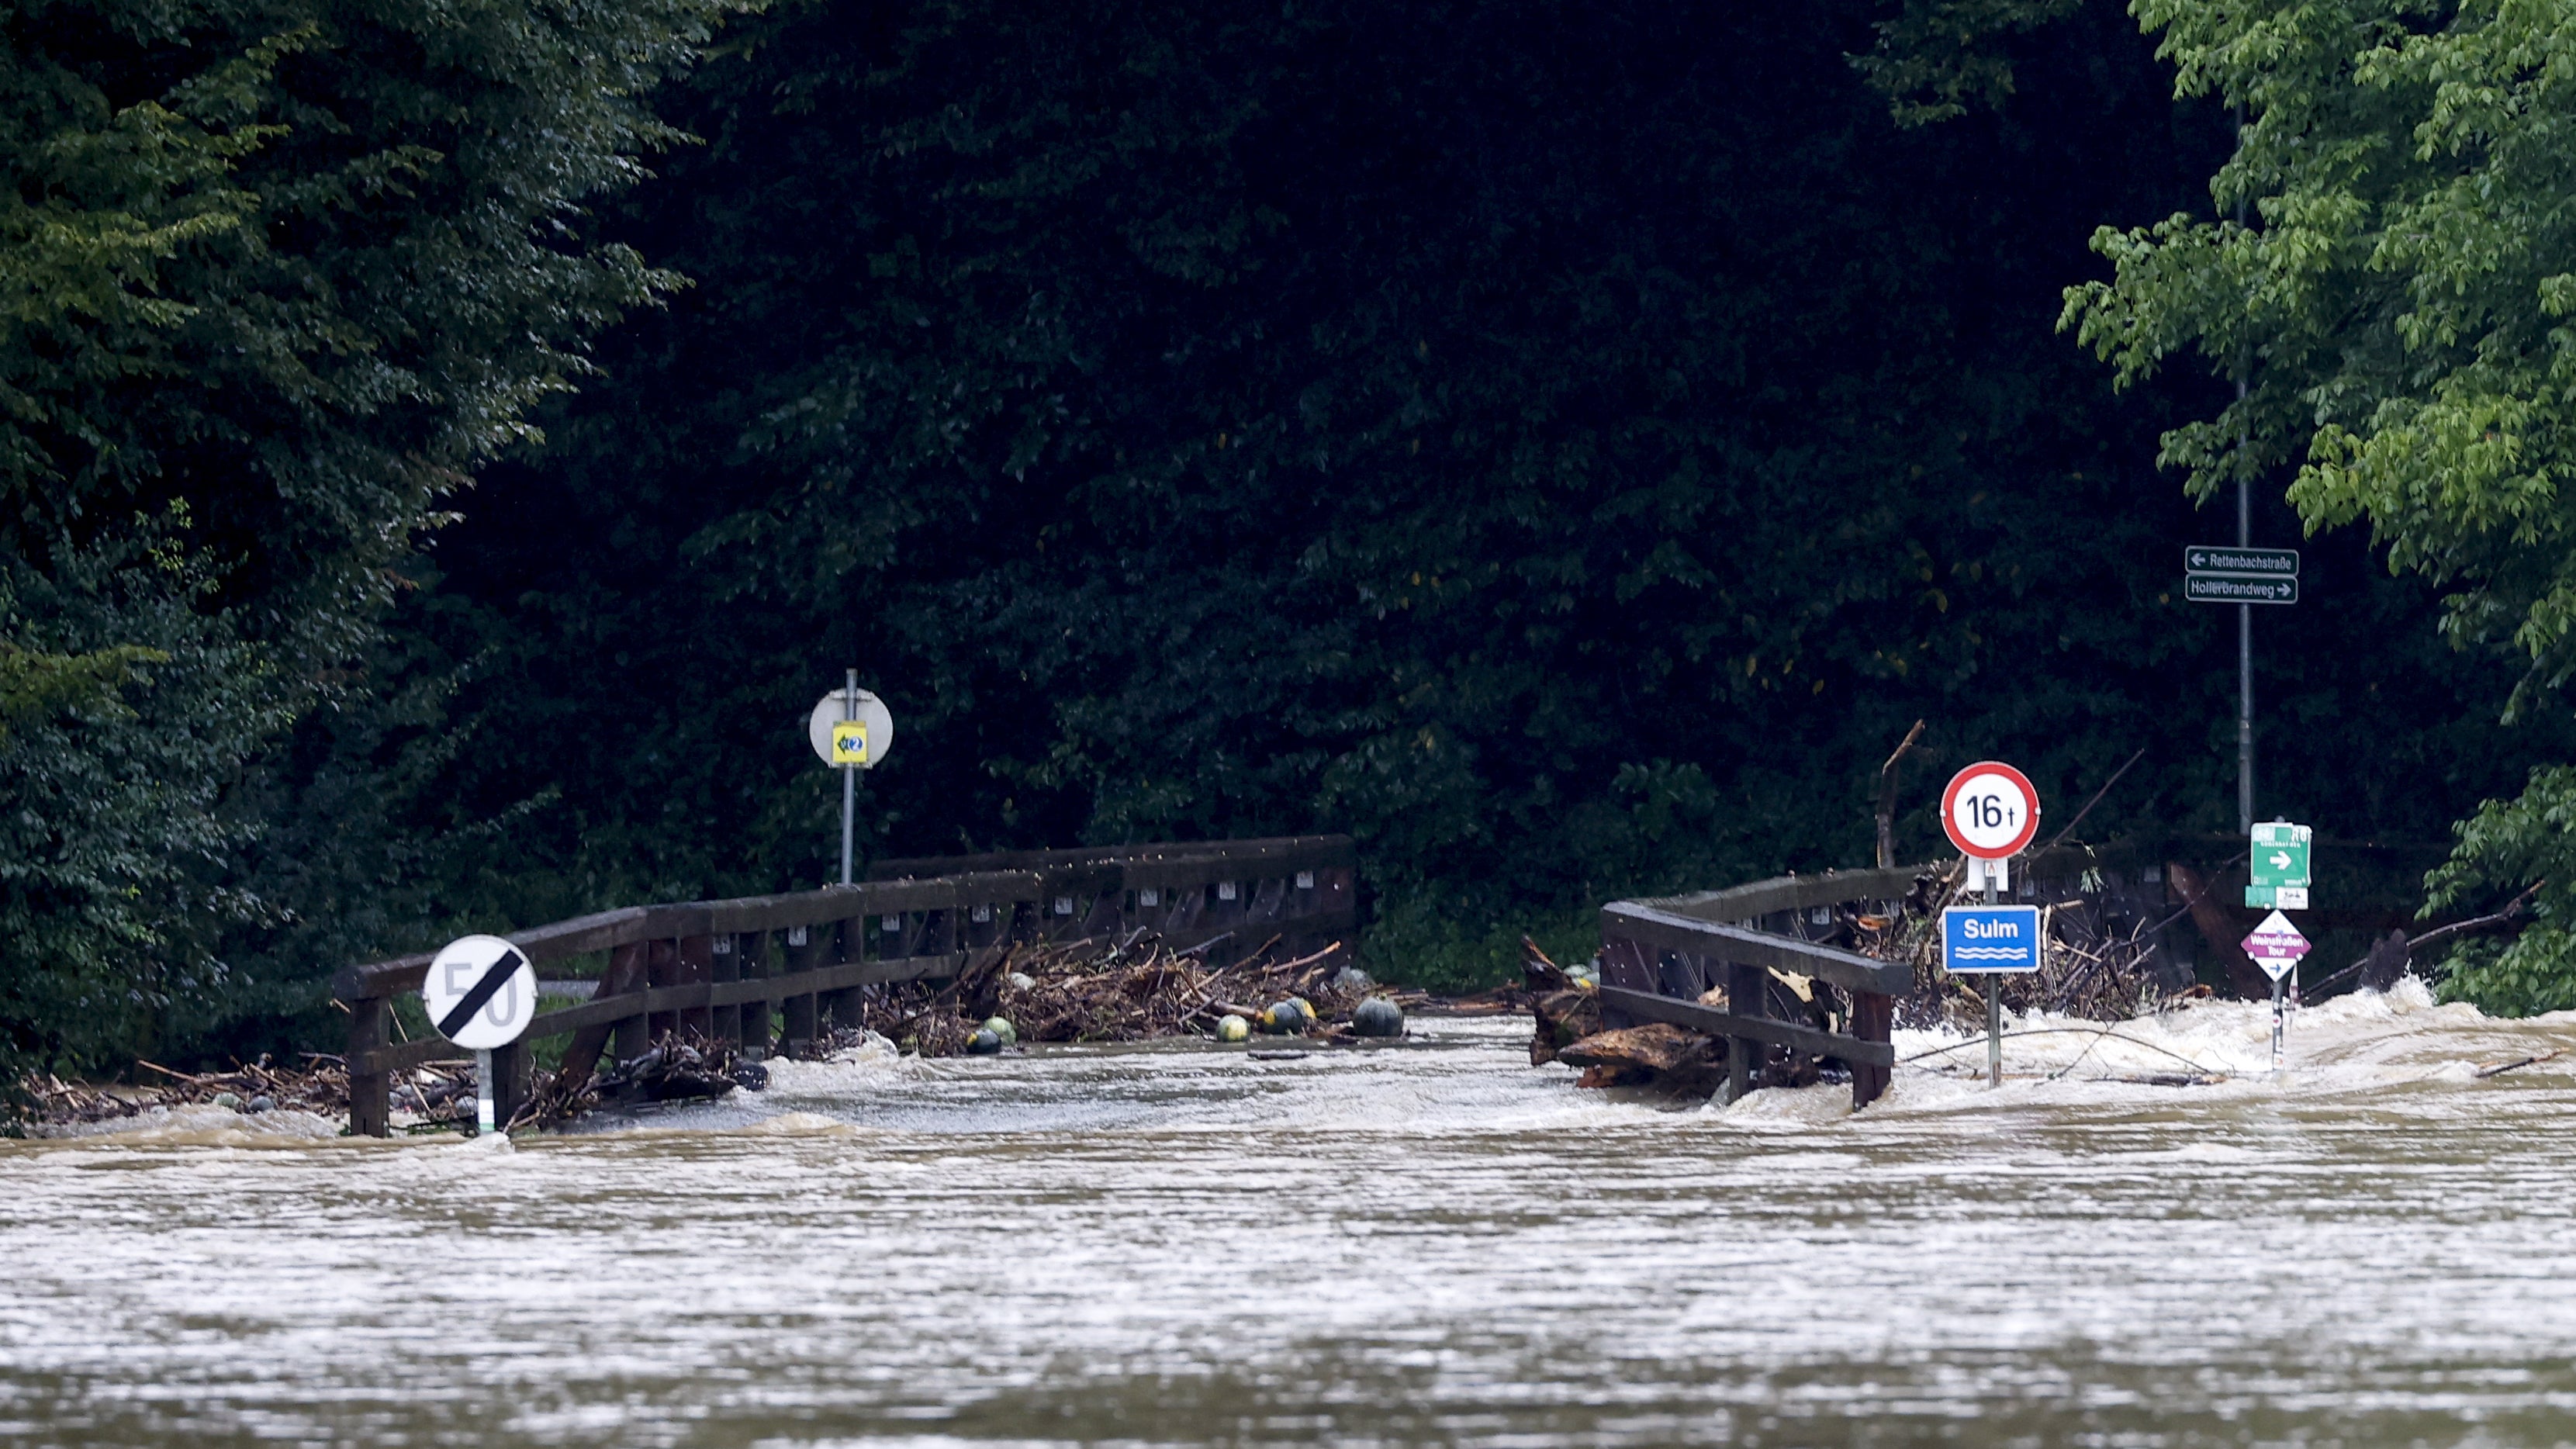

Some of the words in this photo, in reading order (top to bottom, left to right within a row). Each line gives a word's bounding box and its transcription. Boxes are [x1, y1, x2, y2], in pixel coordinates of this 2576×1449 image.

[2209, 552, 2292, 570] Rettenbachstraße
[1966, 794, 2003, 828] 16
[2007, 806, 2015, 828] t
[1963, 918, 2019, 939] Sulm
[2250, 934, 2305, 948] Weinstraßen
[2267, 945, 2287, 957] Tour
[444, 962, 517, 1027] 50
